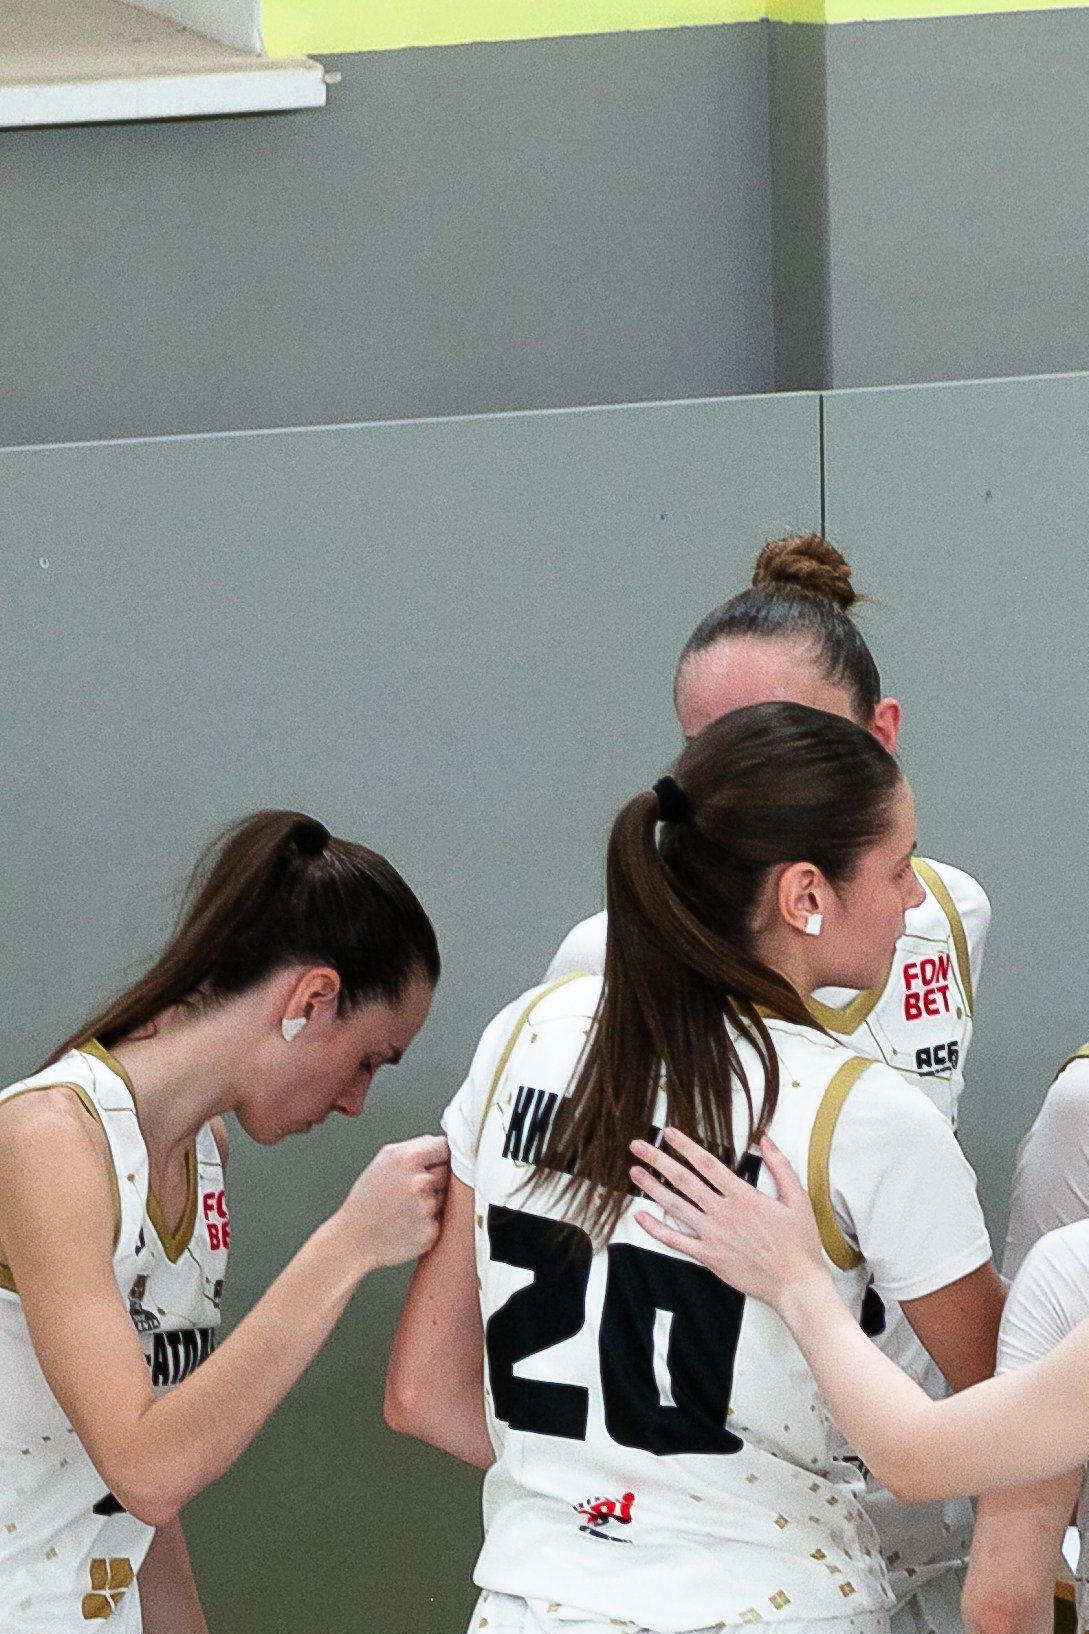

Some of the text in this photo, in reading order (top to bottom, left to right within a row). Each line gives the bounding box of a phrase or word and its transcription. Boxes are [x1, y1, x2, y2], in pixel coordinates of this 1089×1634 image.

[903, 953, 950, 991] FON
[904, 985, 950, 1021] BET
[203, 1190, 228, 1221] FO
[206, 1221, 230, 1251] BE
[486, 1203, 746, 1456] 20
